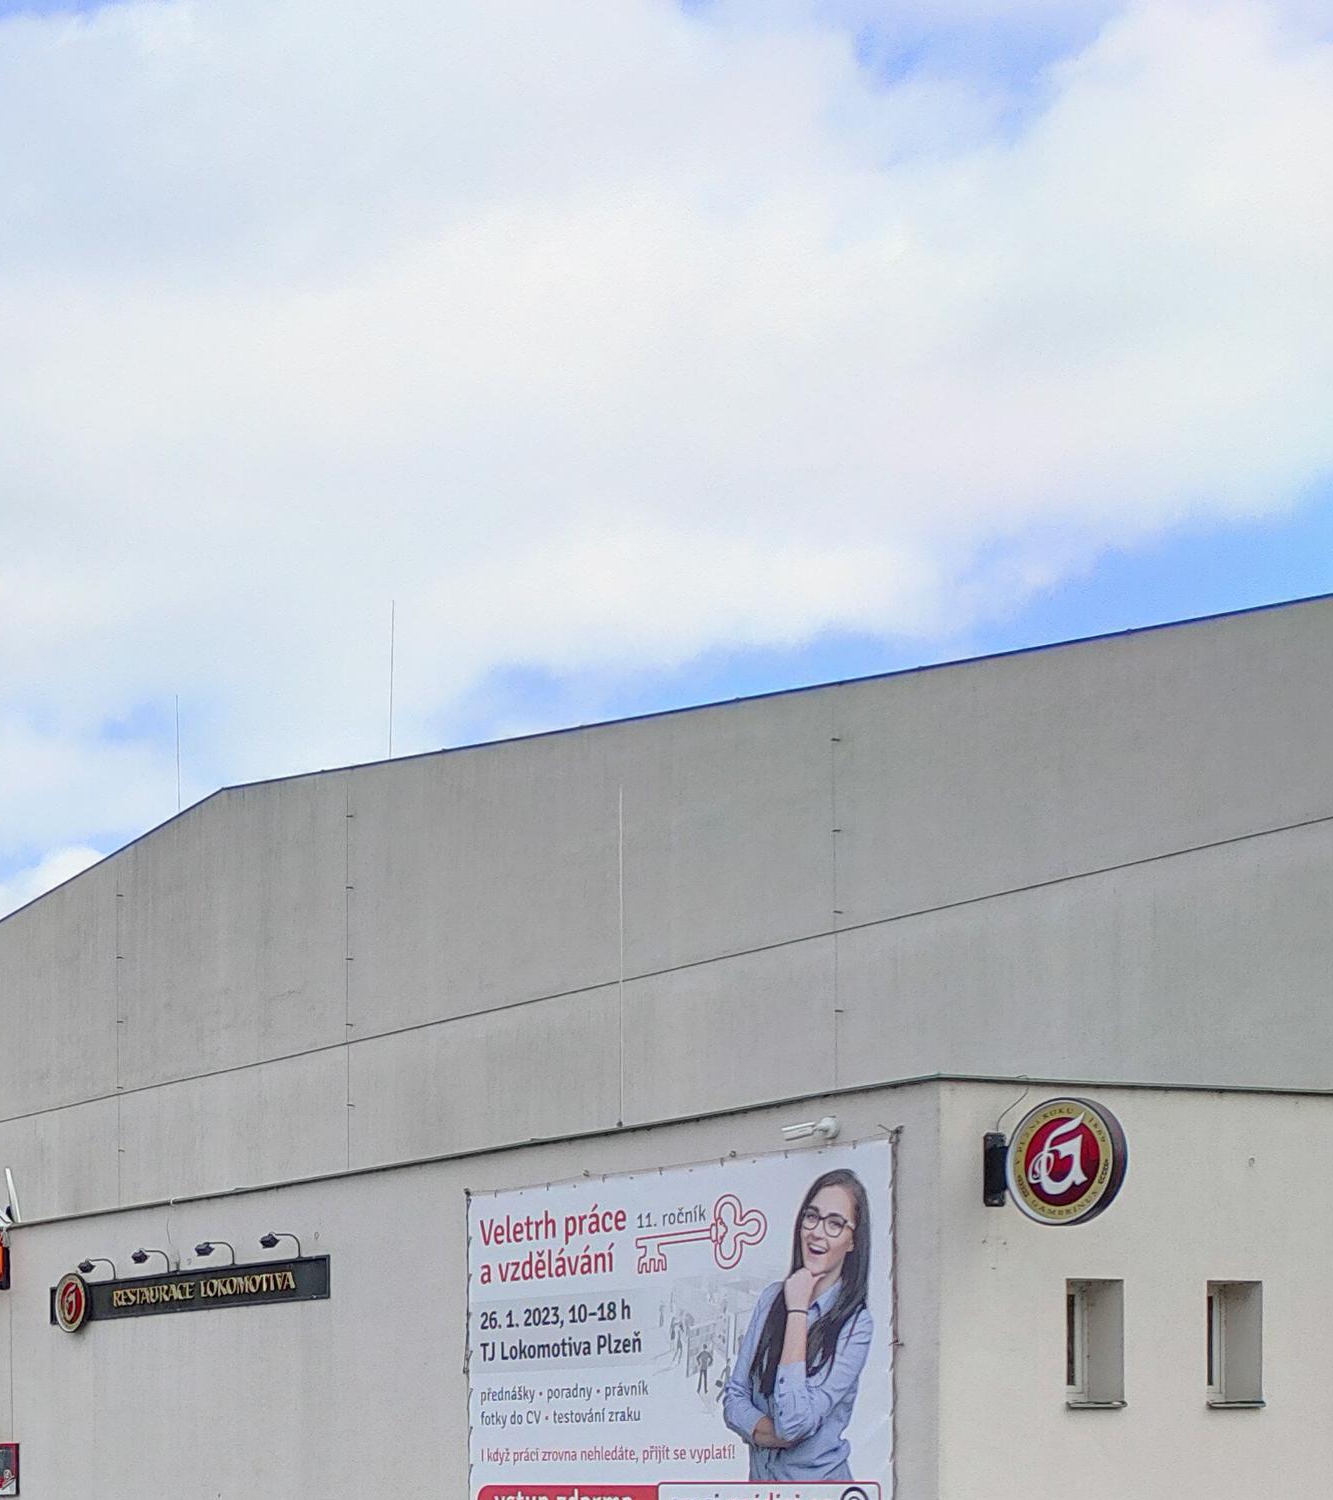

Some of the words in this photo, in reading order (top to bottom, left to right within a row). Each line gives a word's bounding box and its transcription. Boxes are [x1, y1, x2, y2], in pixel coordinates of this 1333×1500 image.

[480, 1210, 556, 1246] Veletrh
[565, 1204, 627, 1245] práce
[637, 1212, 657, 1228] 11.
[662, 1204, 707, 1226] ročník
[480, 1264, 492, 1285] a
[498, 1242, 615, 1284] vzdělávání
[113, 1281, 195, 1308] RESTAURACE
[200, 1271, 296, 1300] LOKOMOTIVA
[480, 1311, 502, 1330] 26.
[506, 1310, 519, 1328] 1.
[523, 1306, 564, 1329] 2023,
[621, 1298, 631, 1320] h
[480, 1342, 495, 1362] TJ
[501, 1337, 591, 1361] Lokomotiva
[597, 1331, 642, 1355] Plzeň
[480, 1386, 535, 1405] přednášky
[547, 1384, 593, 1402] poradny
[605, 1380, 649, 1399] právník
[480, 1411, 507, 1429] fotky
[510, 1410, 523, 1425] do
[526, 1411, 541, 1425] CV
[553, 1408, 605, 1424] testování
[608, 1407, 641, 1422] zraku
[481, 1449, 484, 1462] I
[487, 1448, 510, 1466] když
[513, 1448, 539, 1466] práci
[541, 1450, 577, 1462] zrovna
[580, 1445, 638, 1463] nehledáte,
[642, 1444, 670, 1464] přijít
[673, 1449, 686, 1460] se
[690, 1443, 736, 1464] vyplatí!
